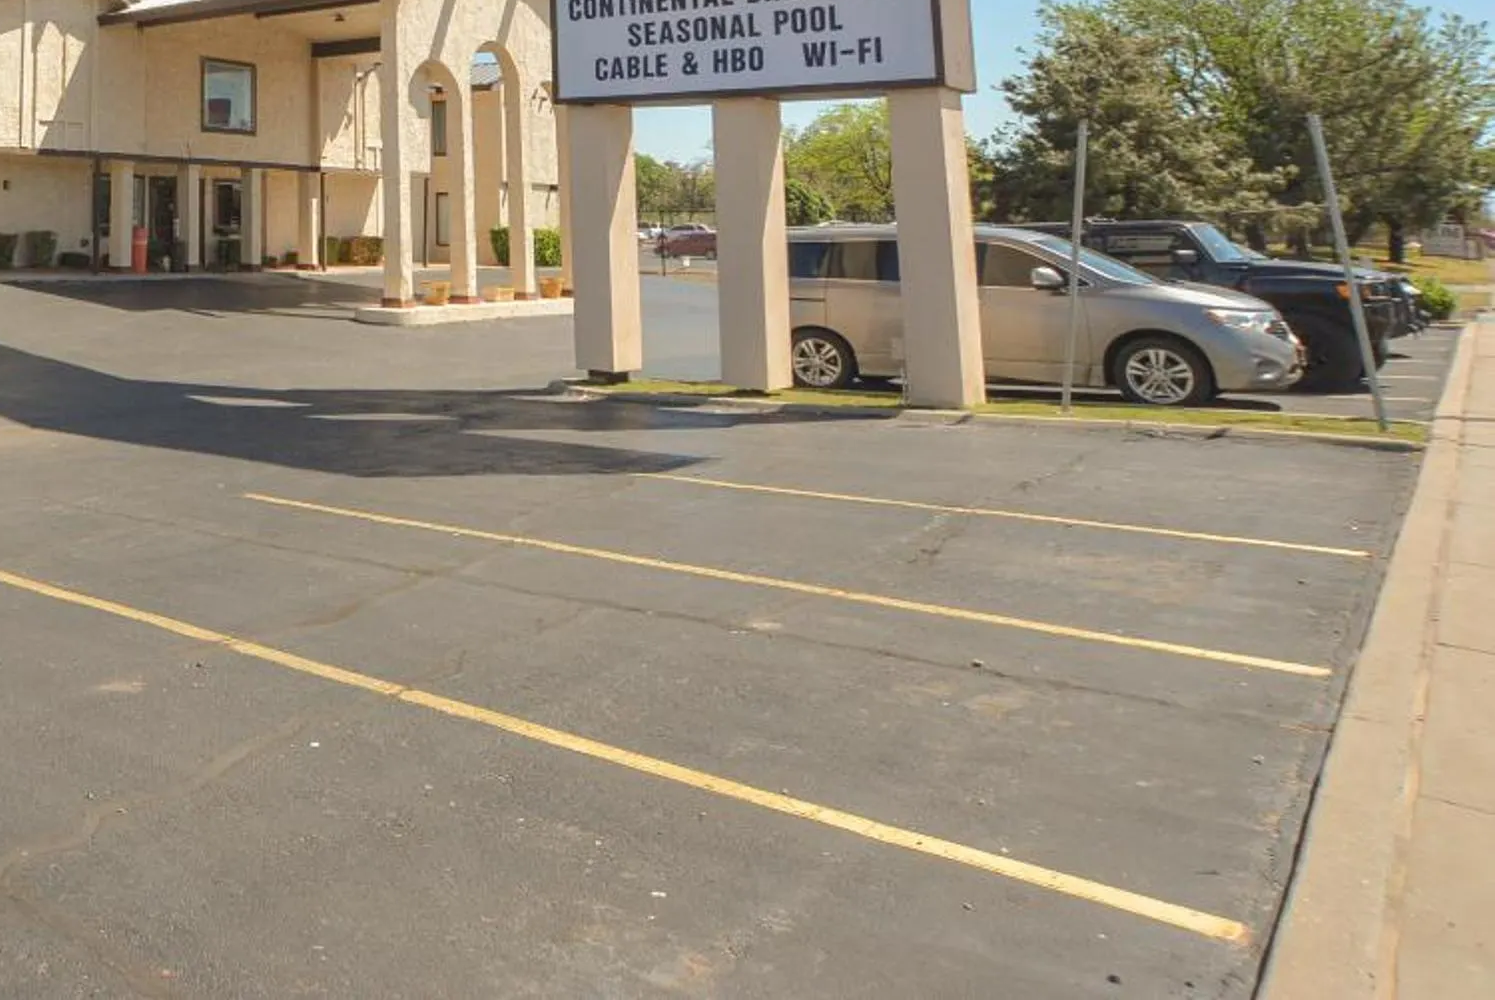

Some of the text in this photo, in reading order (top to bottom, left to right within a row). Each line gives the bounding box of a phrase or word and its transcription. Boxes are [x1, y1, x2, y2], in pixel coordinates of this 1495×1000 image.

[627, 5, 843, 47] SEASONAL POOL
[594, 37, 882, 81] CABLE & HBO WI-FI
